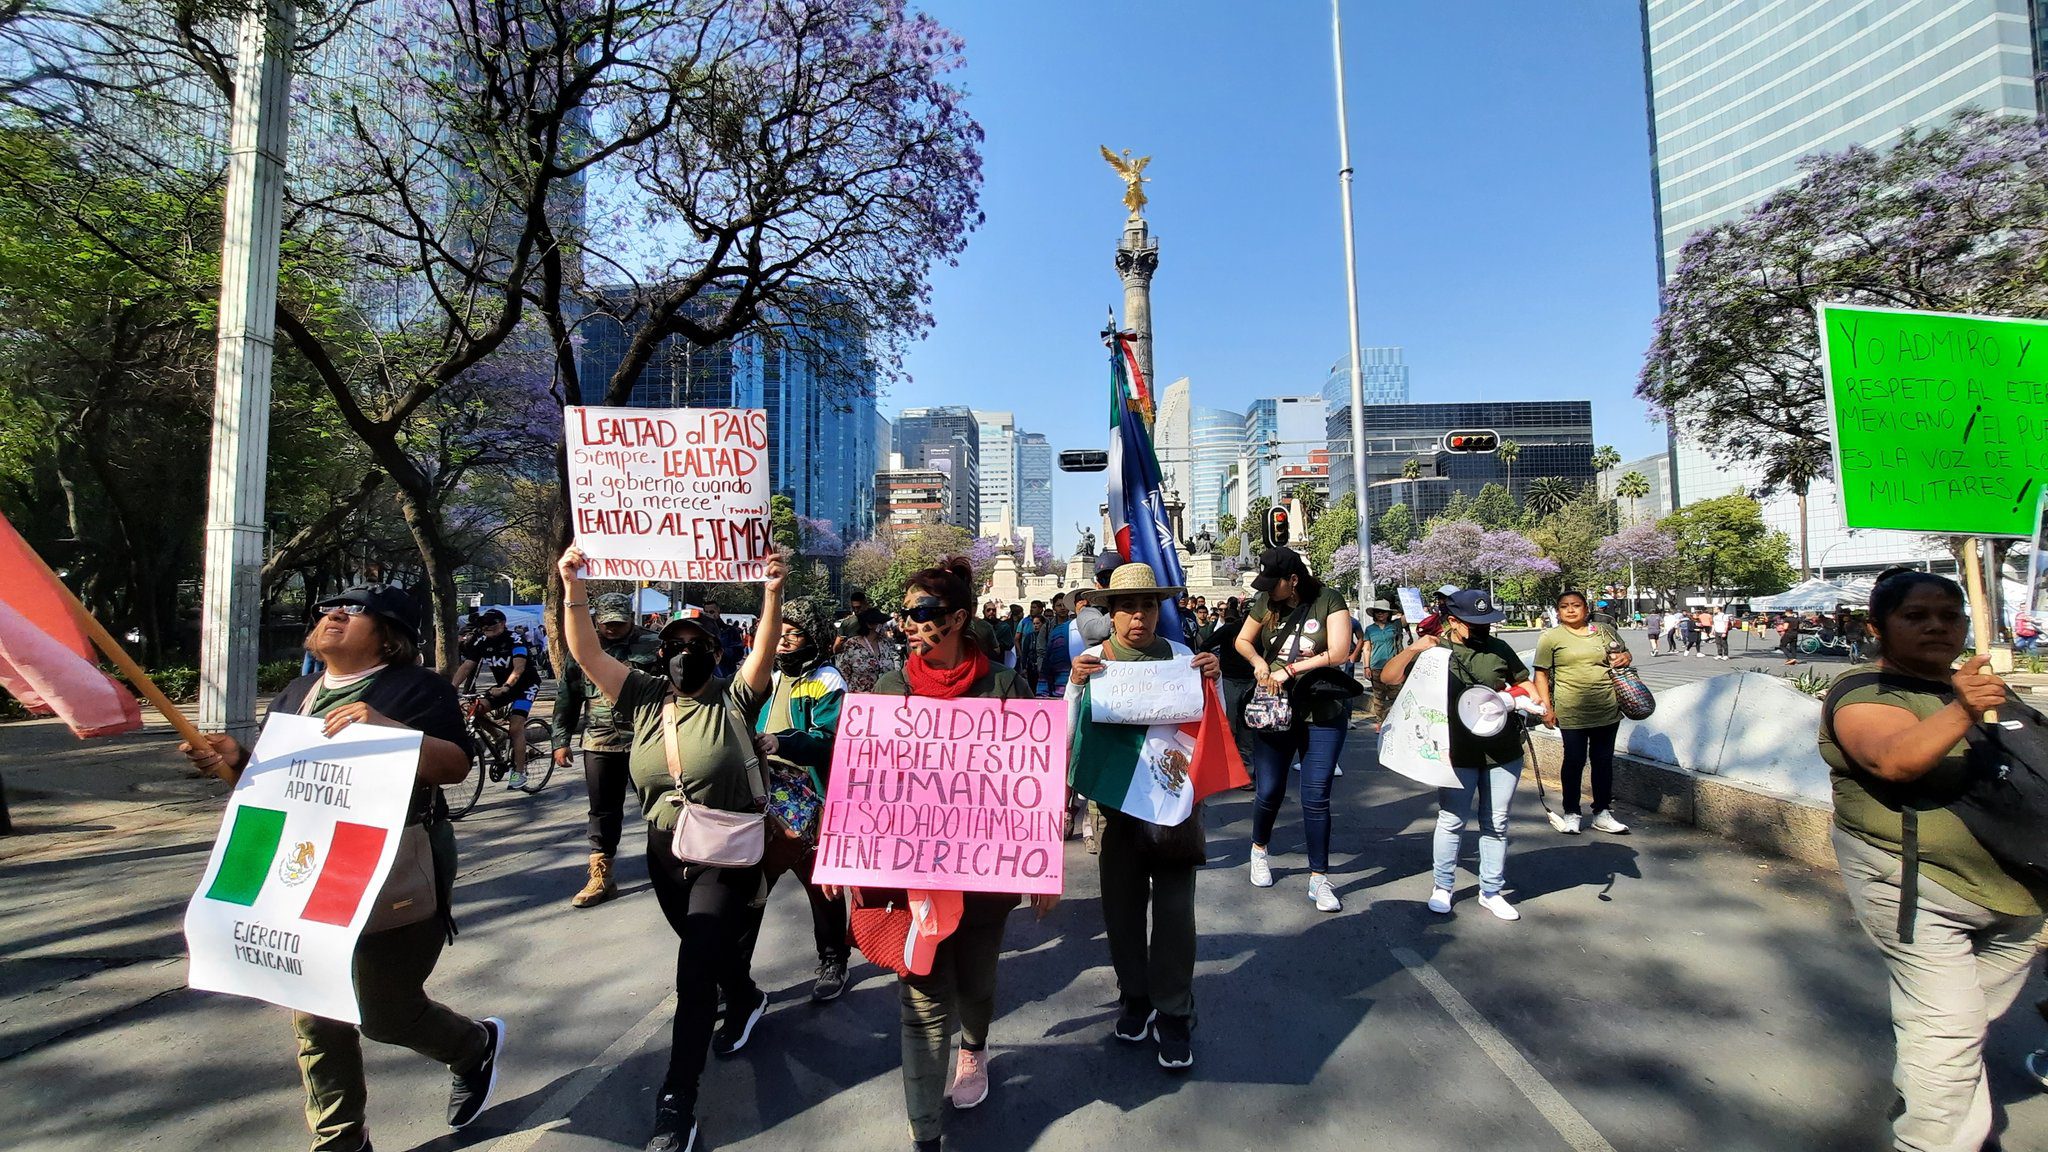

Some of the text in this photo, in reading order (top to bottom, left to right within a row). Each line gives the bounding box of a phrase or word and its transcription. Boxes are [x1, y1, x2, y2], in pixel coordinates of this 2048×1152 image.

[1840, 319, 2031, 368] YO ADMIRO Y
[1846, 377, 2048, 404] RESPETO AL EJE
[686, 416, 705, 444] al
[709, 410, 767, 450] PAÍS
[1841, 407, 1954, 431] MEXICANO
[663, 448, 757, 478] LEALTAD
[1841, 448, 1872, 471] ES
[1881, 447, 1909, 468] LA
[1923, 450, 1970, 470] VOZ
[1985, 450, 2011, 468] DE
[577, 470, 751, 498] al gobierno cuando
[579, 491, 596, 504] se
[618, 491, 633, 508] lo
[578, 508, 773, 561] LEALTAD AL EJEMEX
[585, 558, 763, 581] YO APOYO AL EJERCITO
[845, 705, 1050, 742] EL SOLDADO
[842, 738, 1050, 773] TAMBIEN ES UN
[289, 758, 352, 786] MI TOTAL
[284, 781, 351, 809] APOYO AL
[847, 768, 1042, 809] HUMANO
[827, 801, 1063, 842] EL SOLDADO TAMBIEN
[822, 833, 884, 870] TIENE
